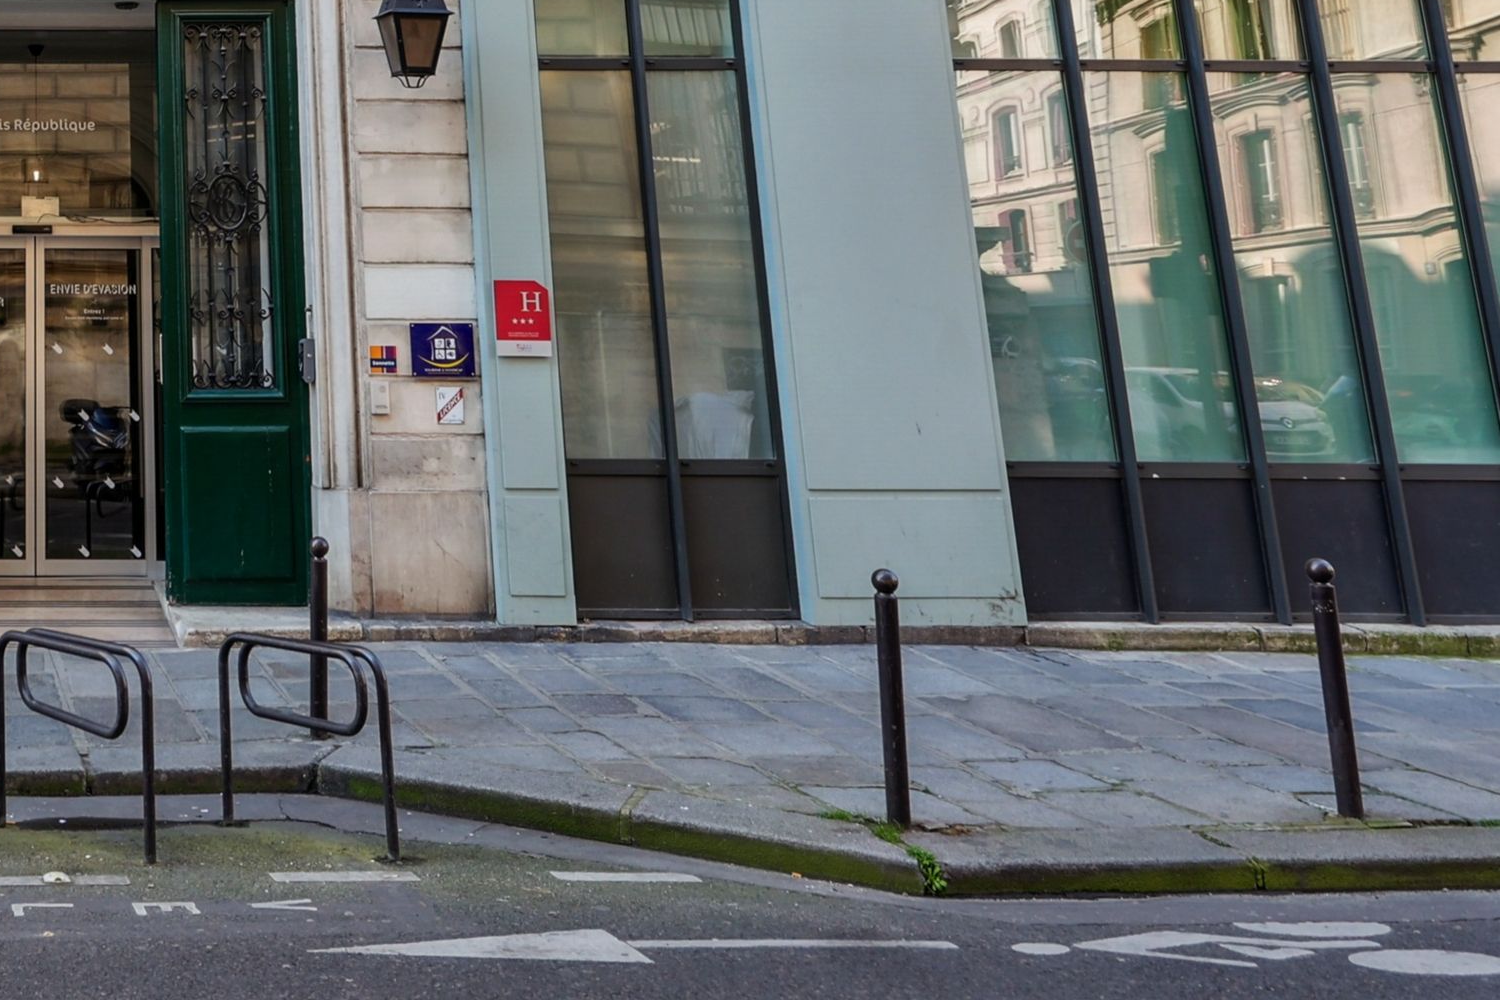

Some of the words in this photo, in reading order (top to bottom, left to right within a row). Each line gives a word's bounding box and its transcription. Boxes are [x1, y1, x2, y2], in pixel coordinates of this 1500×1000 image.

[14, 118, 96, 133] République
[50, 283, 81, 295] ENVIE
[83, 283, 137, 295] D'EVASION
[520, 291, 543, 313] H
